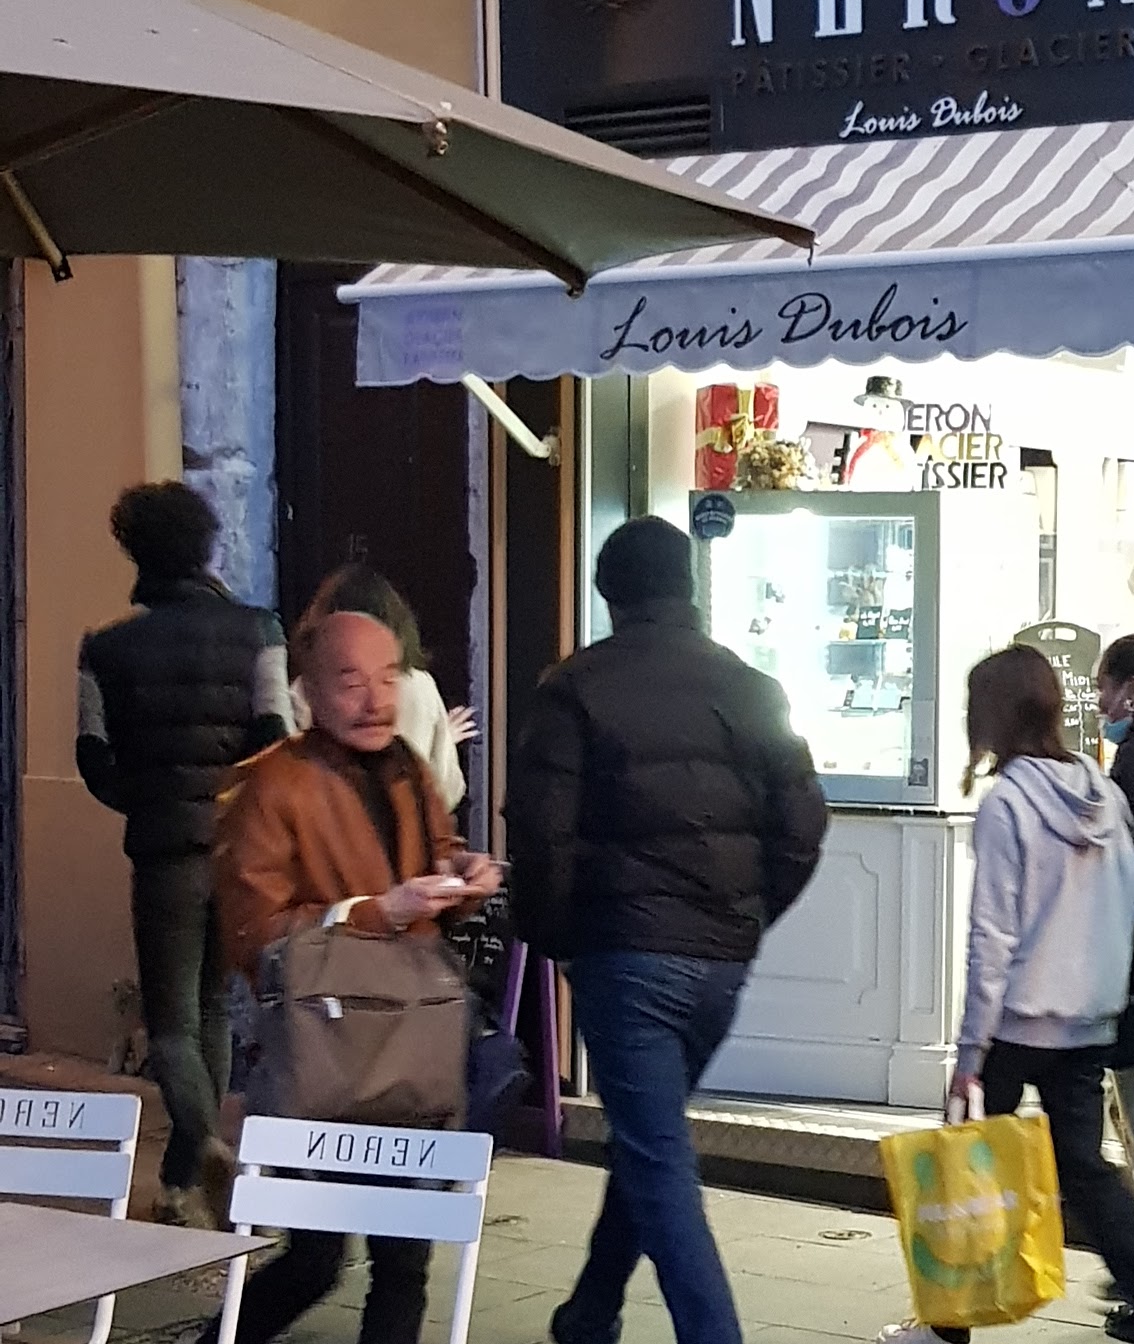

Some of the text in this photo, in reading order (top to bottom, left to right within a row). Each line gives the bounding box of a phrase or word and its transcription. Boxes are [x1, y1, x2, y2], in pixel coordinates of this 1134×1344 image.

[839, 90, 1024, 139] Louis Dubois
[599, 285, 969, 361] Louis Dubois
[906, 403, 992, 433] ERON
